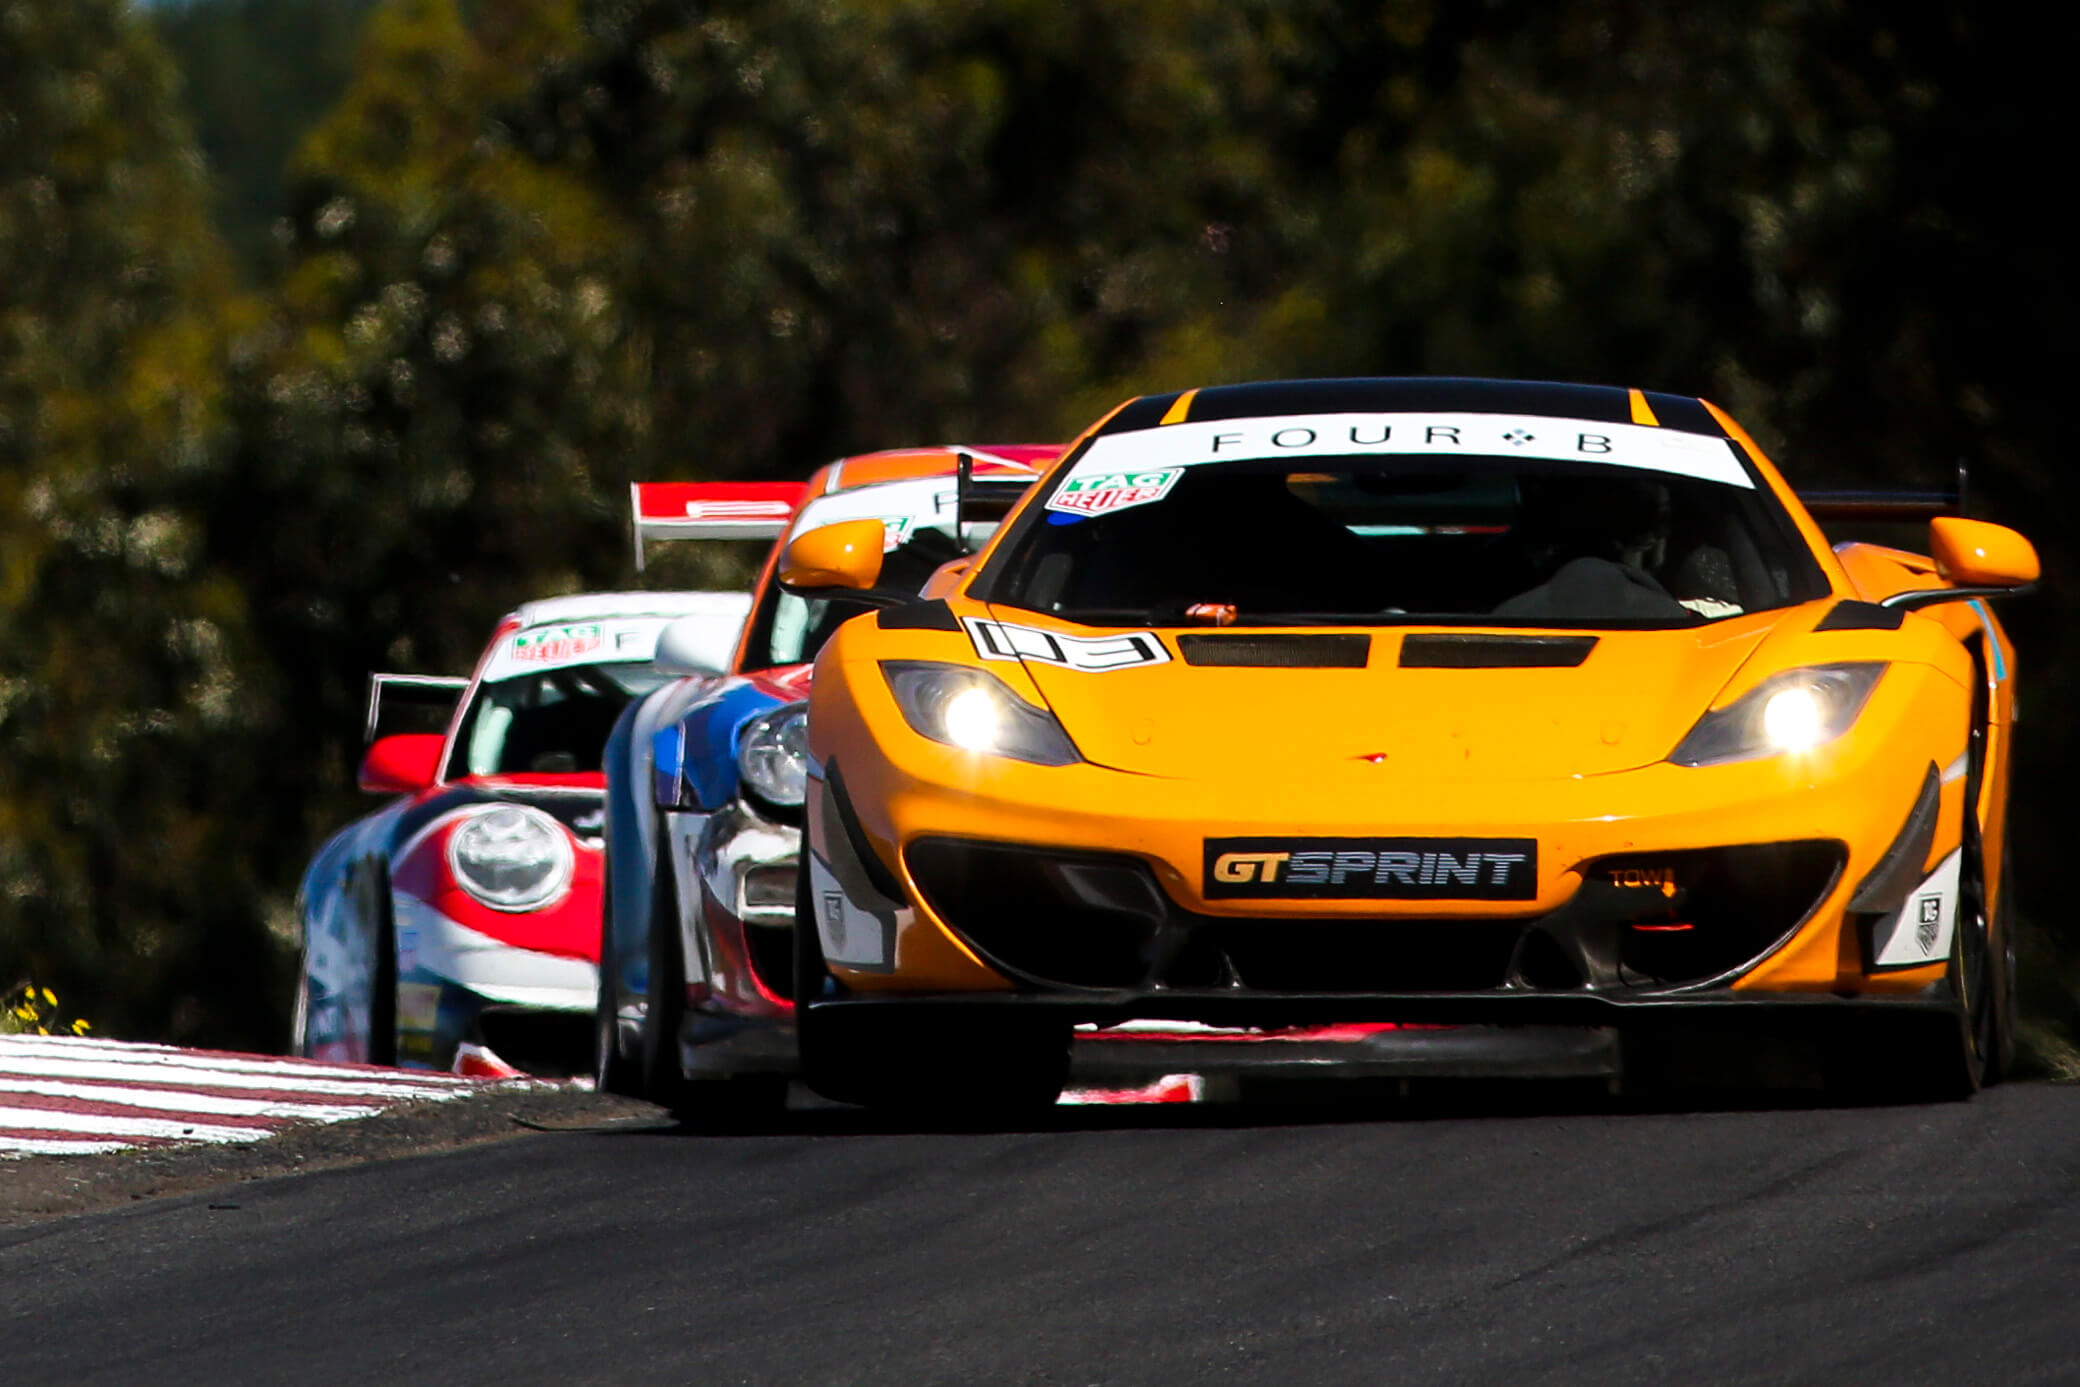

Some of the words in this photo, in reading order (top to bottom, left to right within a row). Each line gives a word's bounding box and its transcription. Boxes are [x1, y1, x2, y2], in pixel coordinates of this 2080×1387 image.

[1211, 426, 1461, 453] FOUR
[1577, 433, 1612, 454] B
[1073, 474, 1166, 492] TAG
[1056, 487, 1160, 512] HEUER
[518, 625, 599, 646] TAG
